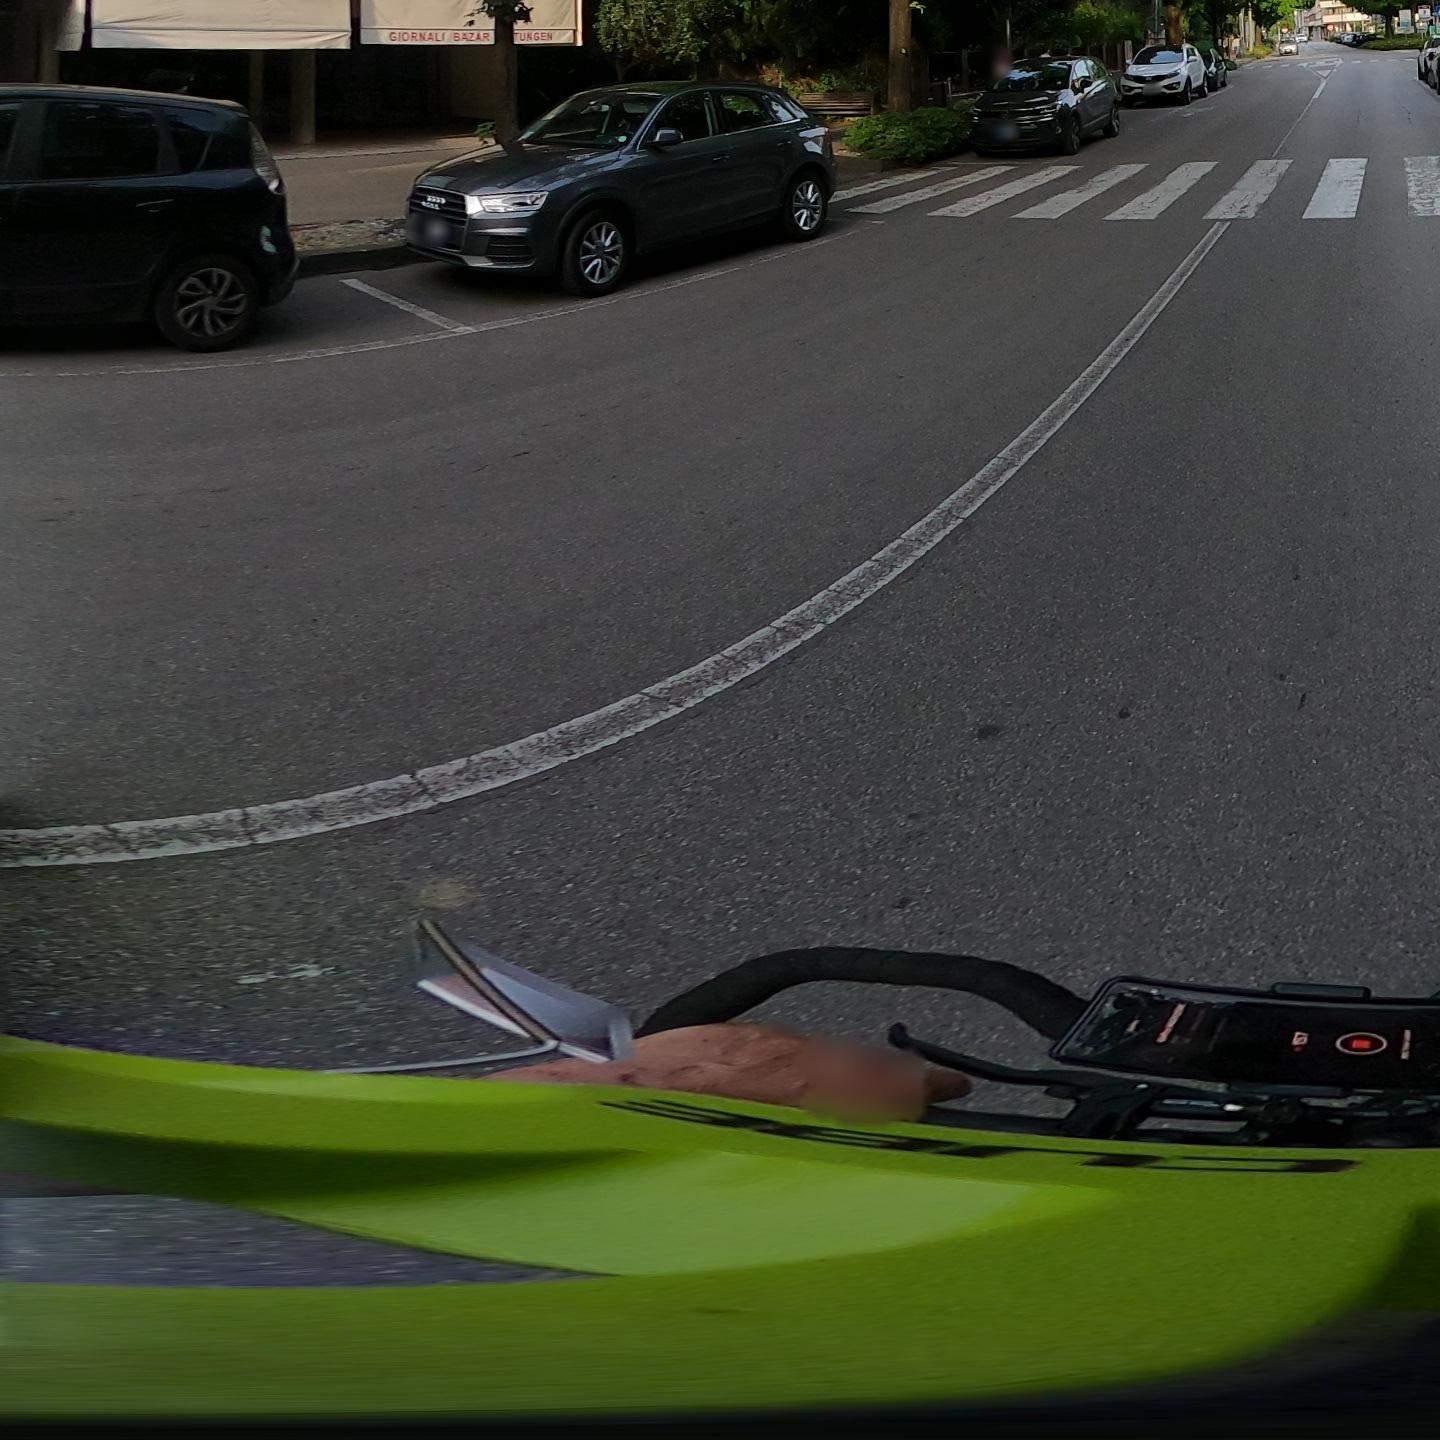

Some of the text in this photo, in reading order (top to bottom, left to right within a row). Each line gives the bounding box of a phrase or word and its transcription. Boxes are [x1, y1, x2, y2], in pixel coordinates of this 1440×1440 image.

[389, 32, 553, 42] GIORNALI BAZAR TUNGEN
[599, 1100, 1360, 1172] CUBE
